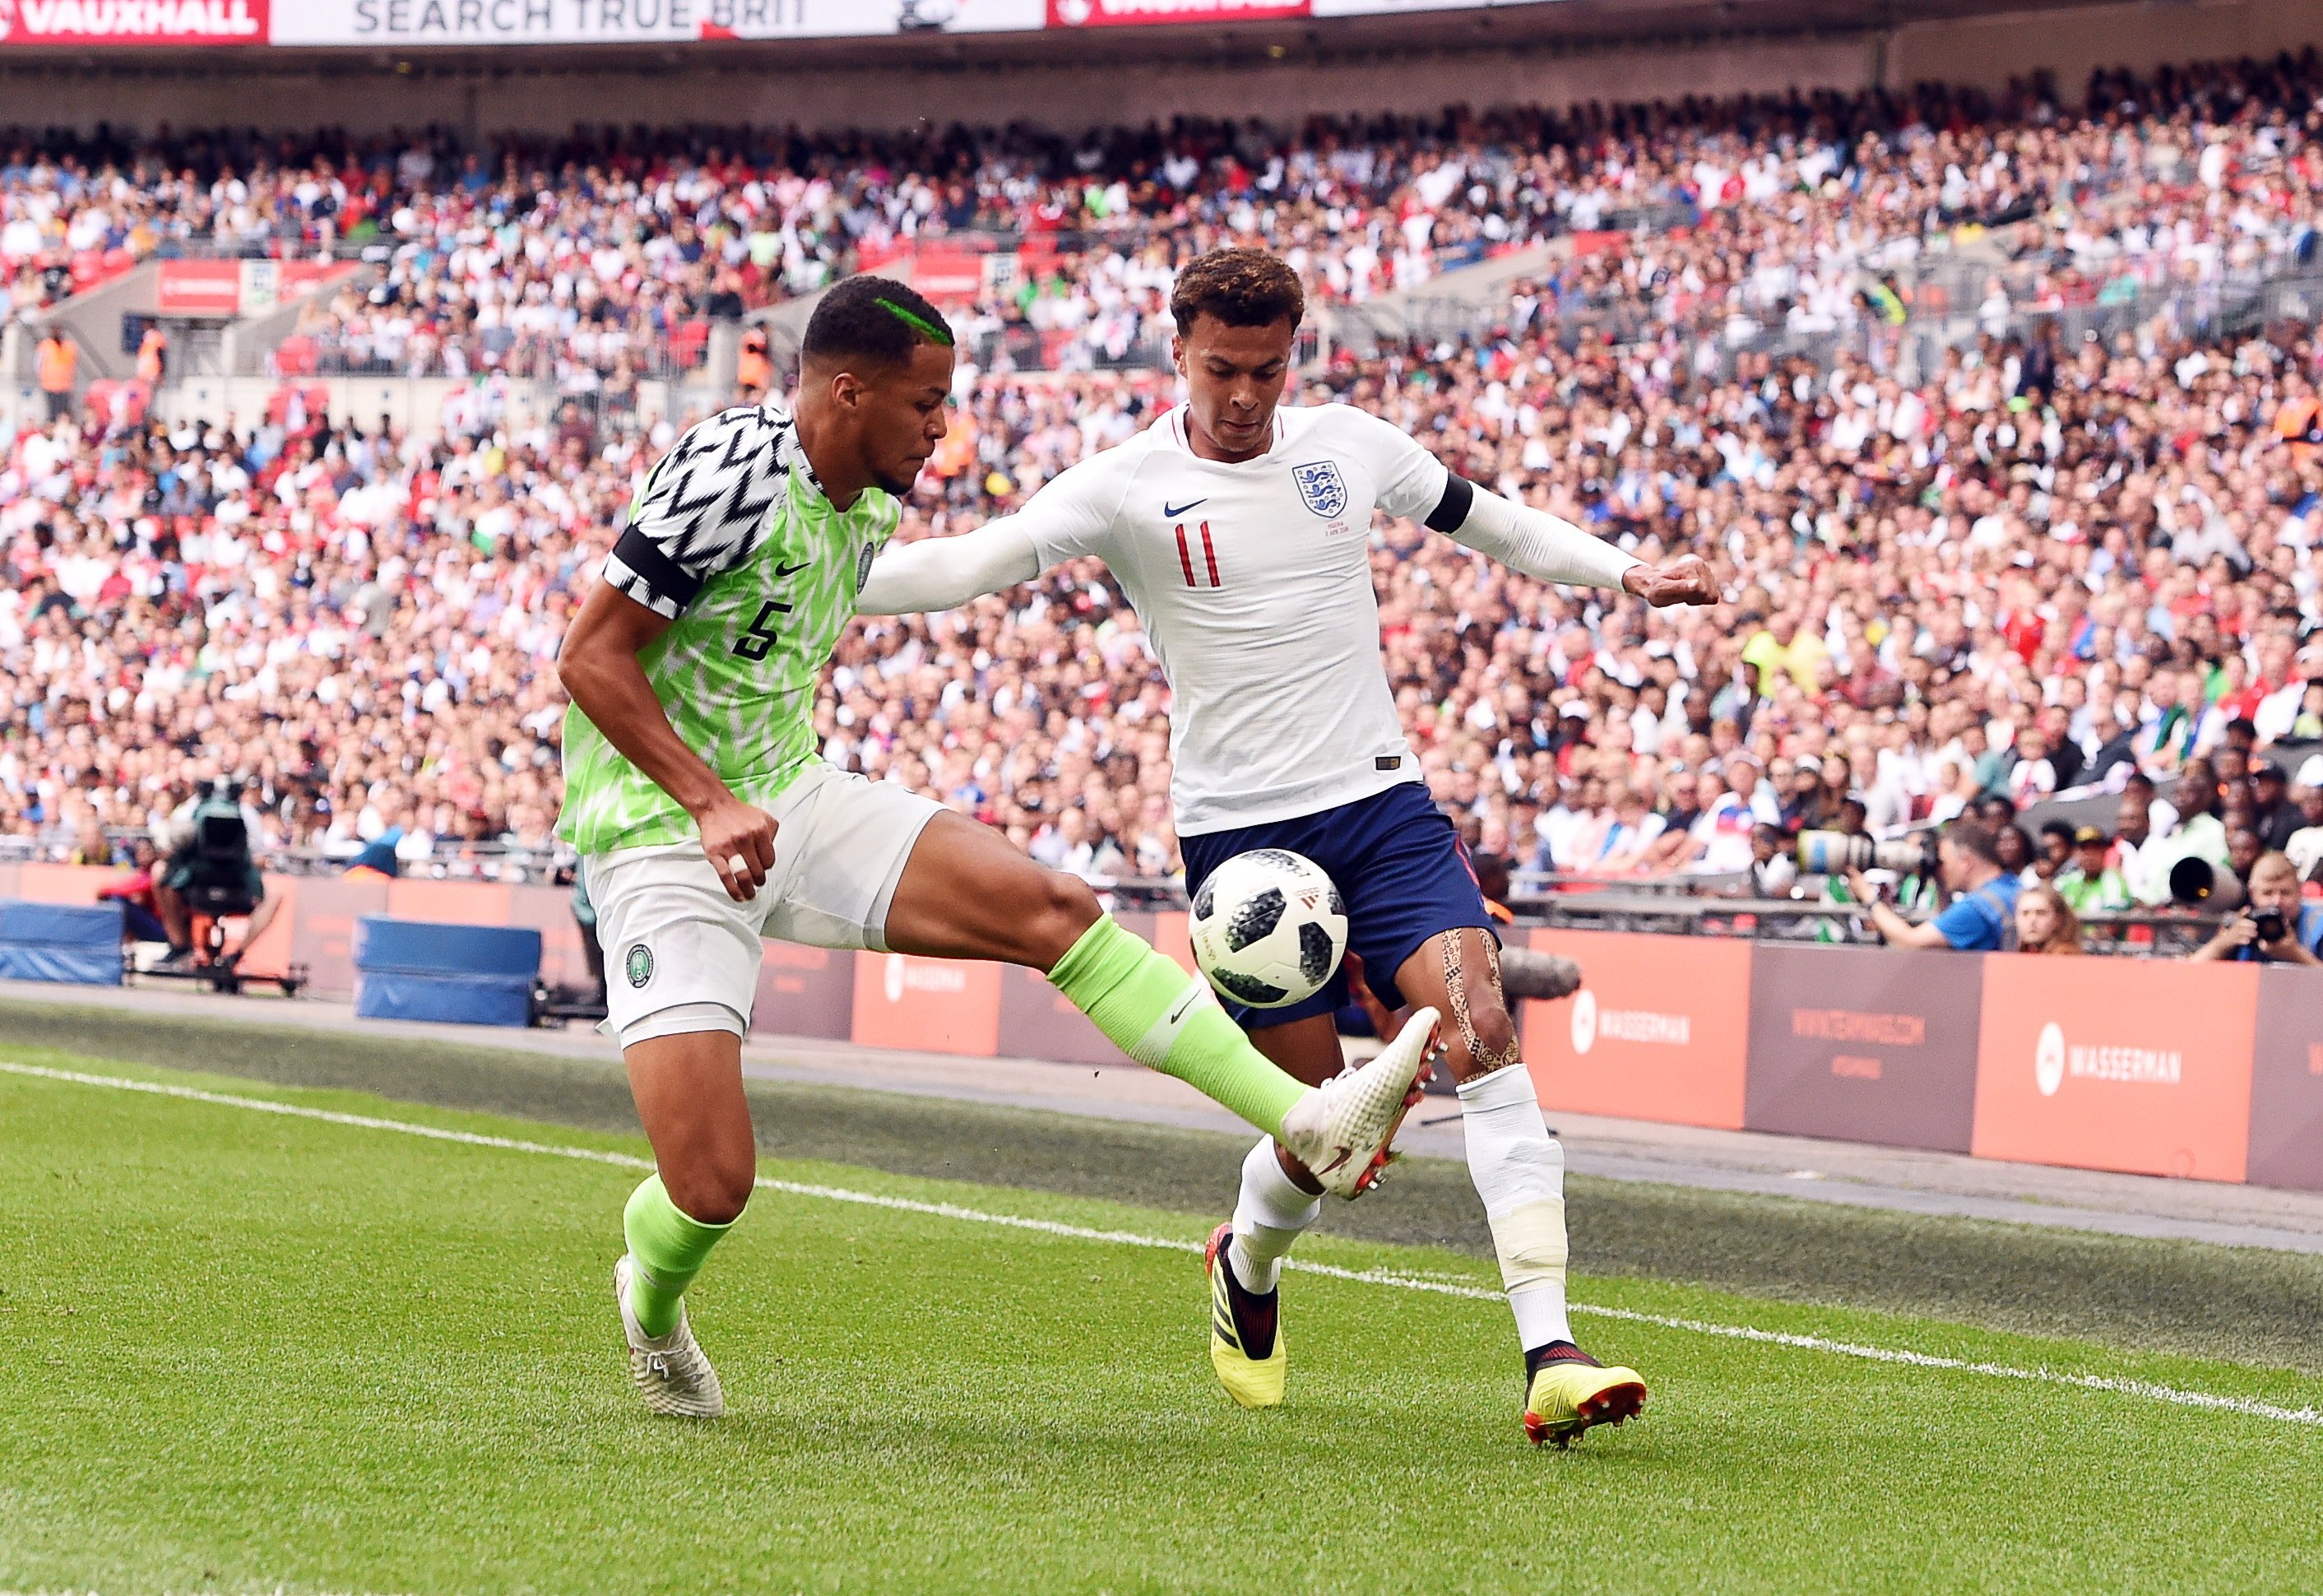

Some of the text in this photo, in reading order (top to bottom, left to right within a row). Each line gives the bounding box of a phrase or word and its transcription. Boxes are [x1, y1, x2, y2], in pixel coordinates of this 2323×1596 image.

[16, 0, 261, 35] VAUXHALL
[355, 0, 552, 32] SEARCH
[573, 0, 690, 29] TRUE
[1175, 520, 1221, 587] 11
[732, 601, 793, 661] 5
[2069, 1044, 2182, 1084] WASSERMAN
